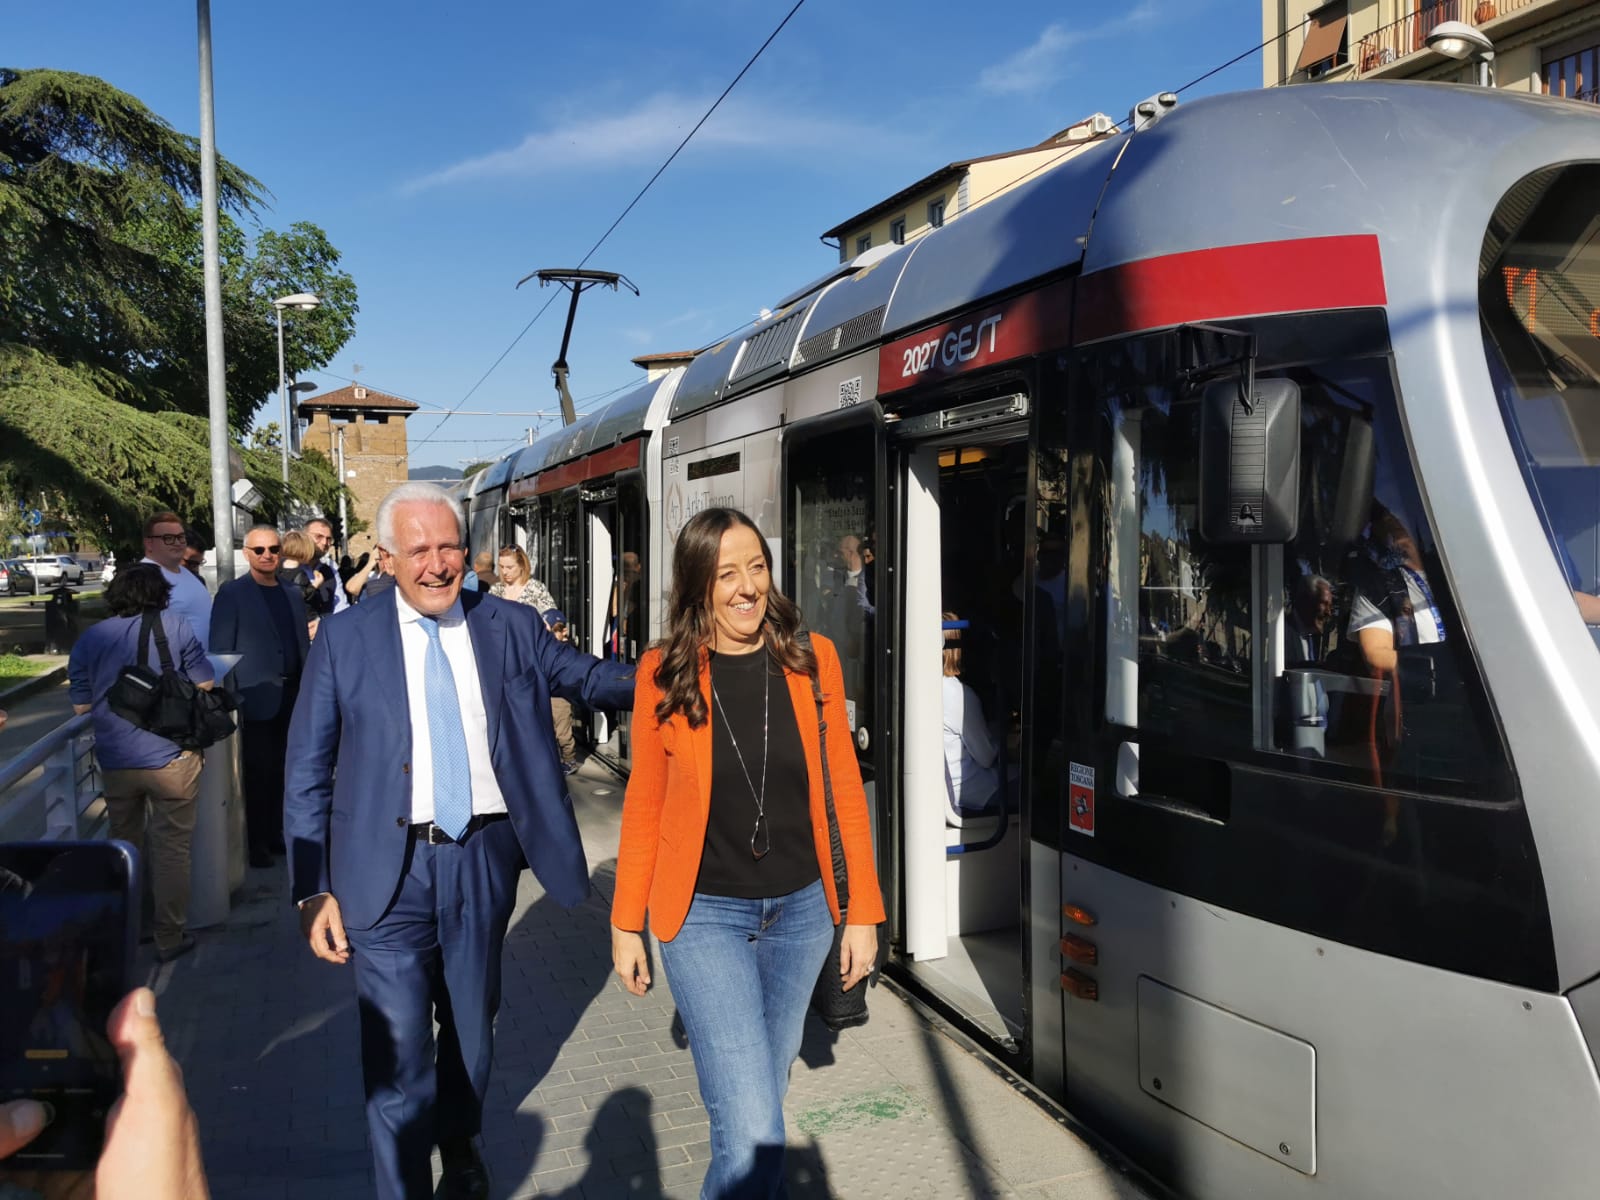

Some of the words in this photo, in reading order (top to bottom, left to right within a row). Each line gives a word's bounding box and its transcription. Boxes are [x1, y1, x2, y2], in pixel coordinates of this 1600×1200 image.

[1502, 266, 1537, 333] T1
[902, 338, 940, 377] 2027
[942, 313, 1002, 366] GEST
[1071, 763, 1094, 777] REGIONE
[1071, 773, 1094, 787] TOSCANA
[830, 818, 847, 884] SALVATORE
